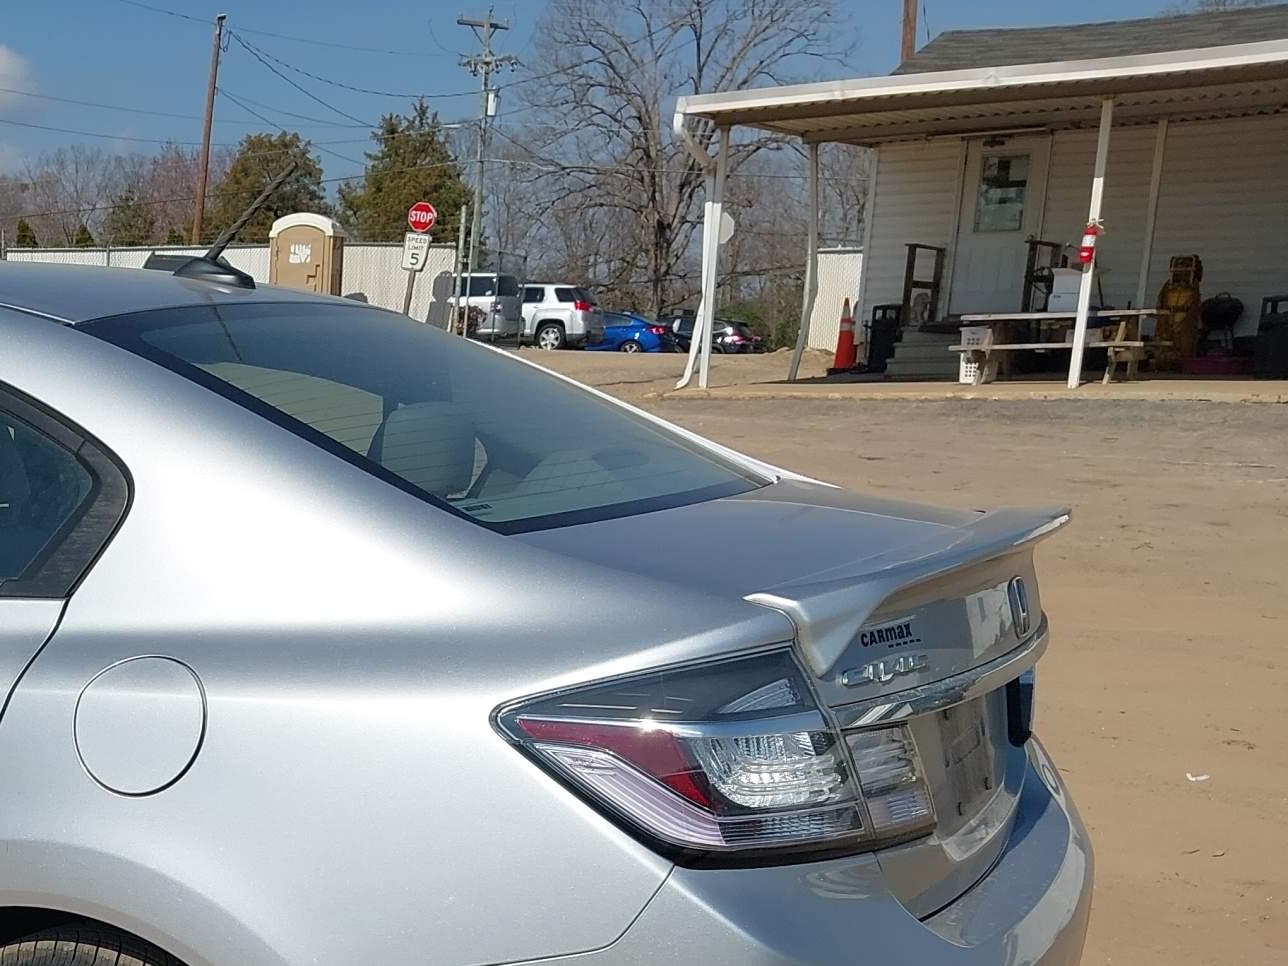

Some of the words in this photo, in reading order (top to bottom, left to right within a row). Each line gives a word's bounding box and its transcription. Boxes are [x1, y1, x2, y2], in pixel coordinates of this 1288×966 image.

[411, 211, 433, 223] STOP
[408, 236, 427, 244] SPEED
[409, 252, 419, 266] 5
